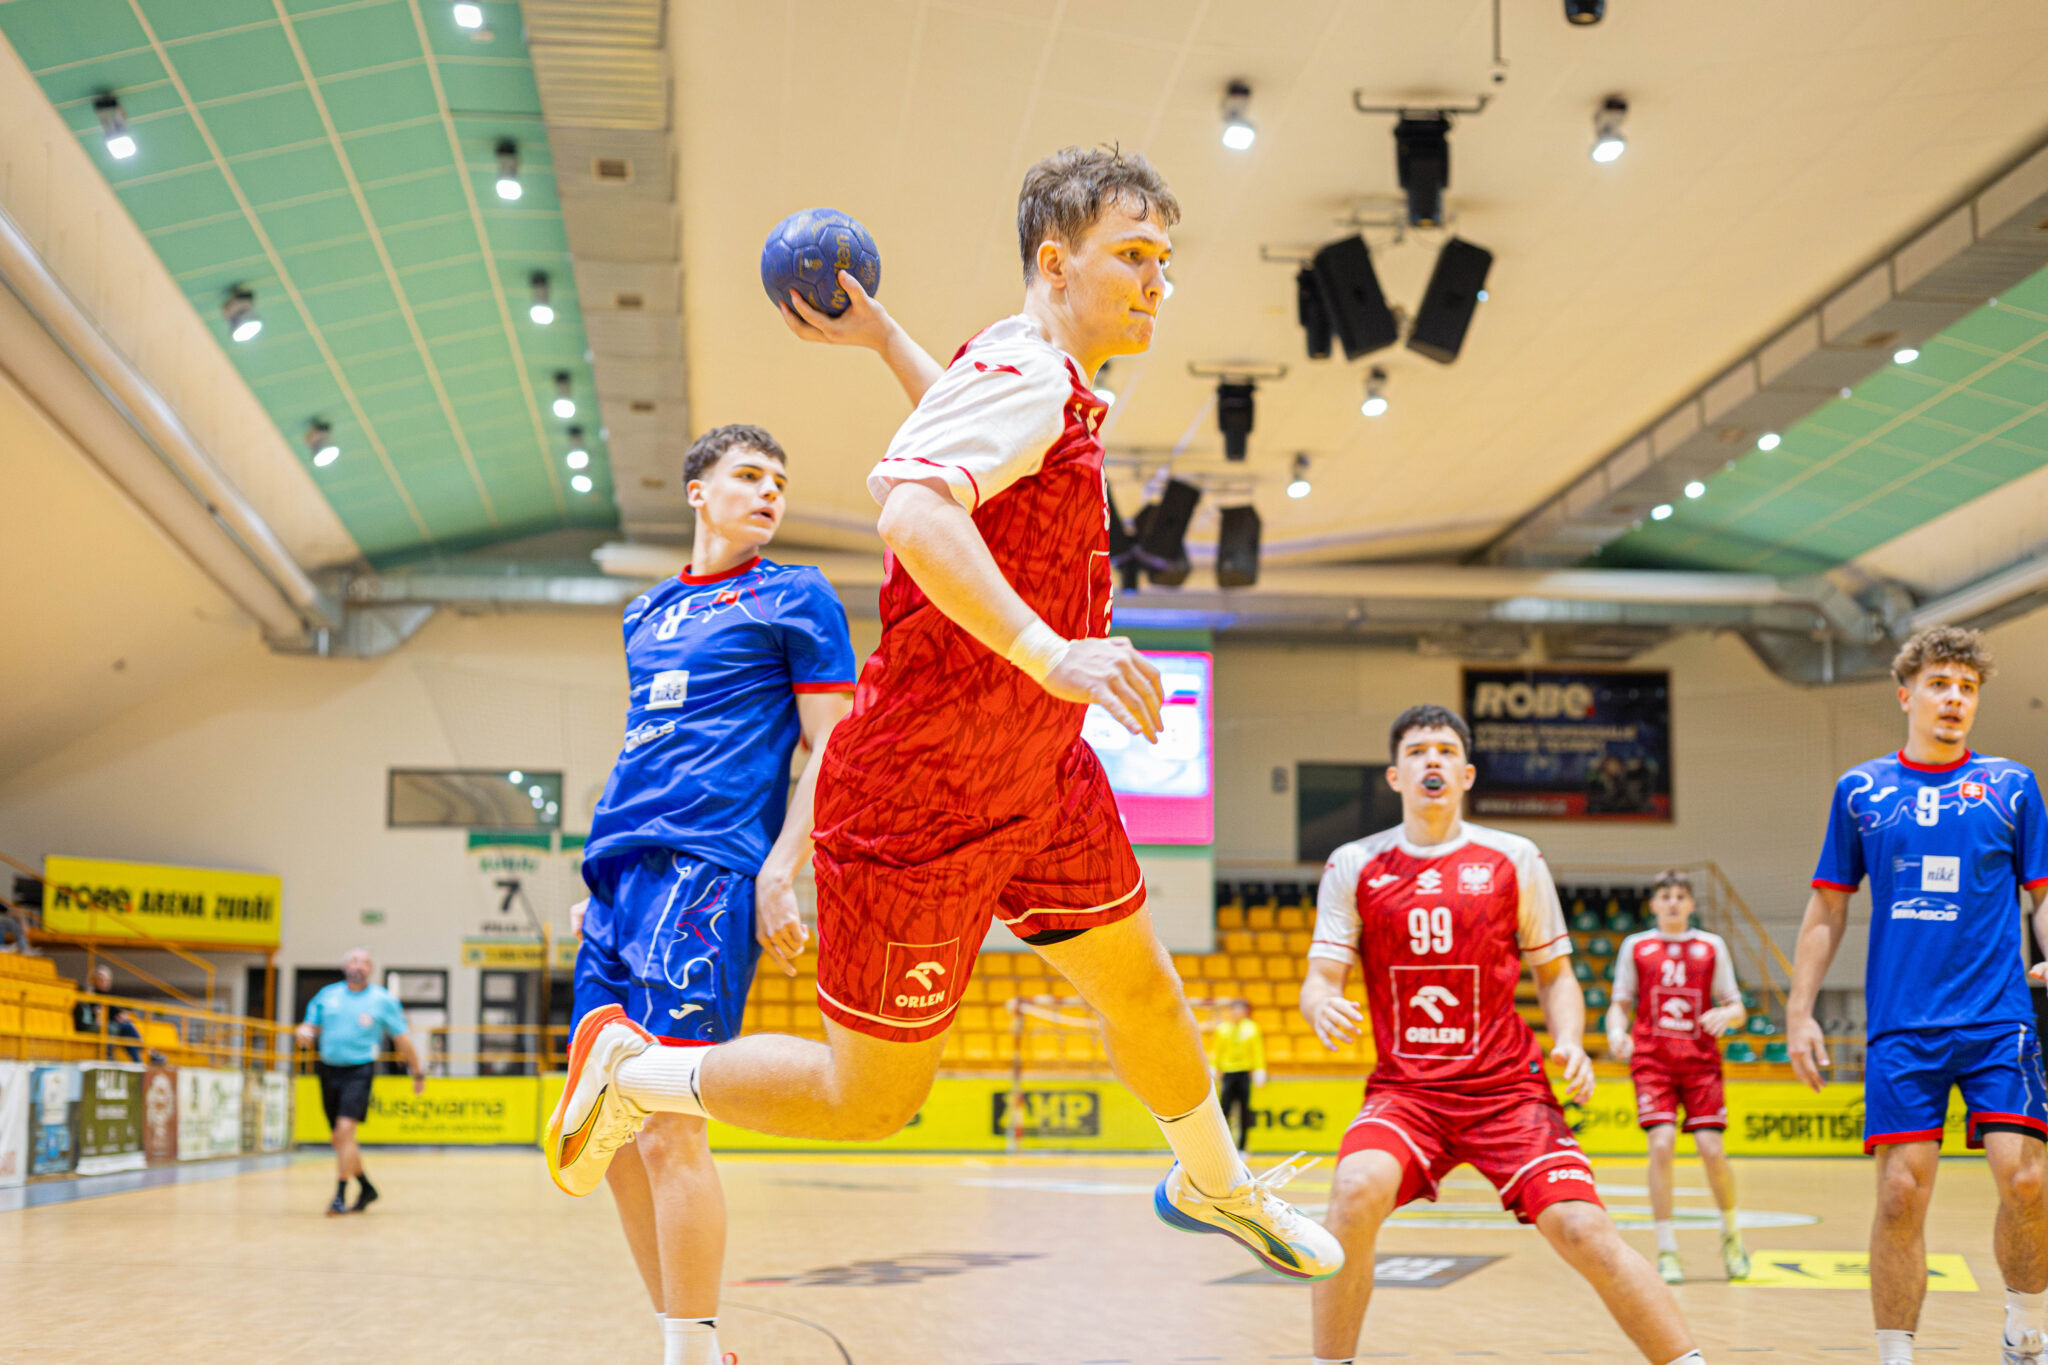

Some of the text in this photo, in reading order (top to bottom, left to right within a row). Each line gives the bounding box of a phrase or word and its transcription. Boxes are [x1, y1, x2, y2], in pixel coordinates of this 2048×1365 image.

[656, 598, 691, 641] 8
[1915, 786, 1940, 827] 9
[139, 889, 205, 918] ARENA
[495, 879, 521, 912] 7
[1408, 907, 1453, 955] 99
[1661, 959, 1687, 987] 24
[895, 990, 945, 1008] ORLEN
[1405, 1026, 1466, 1044] ORLEN
